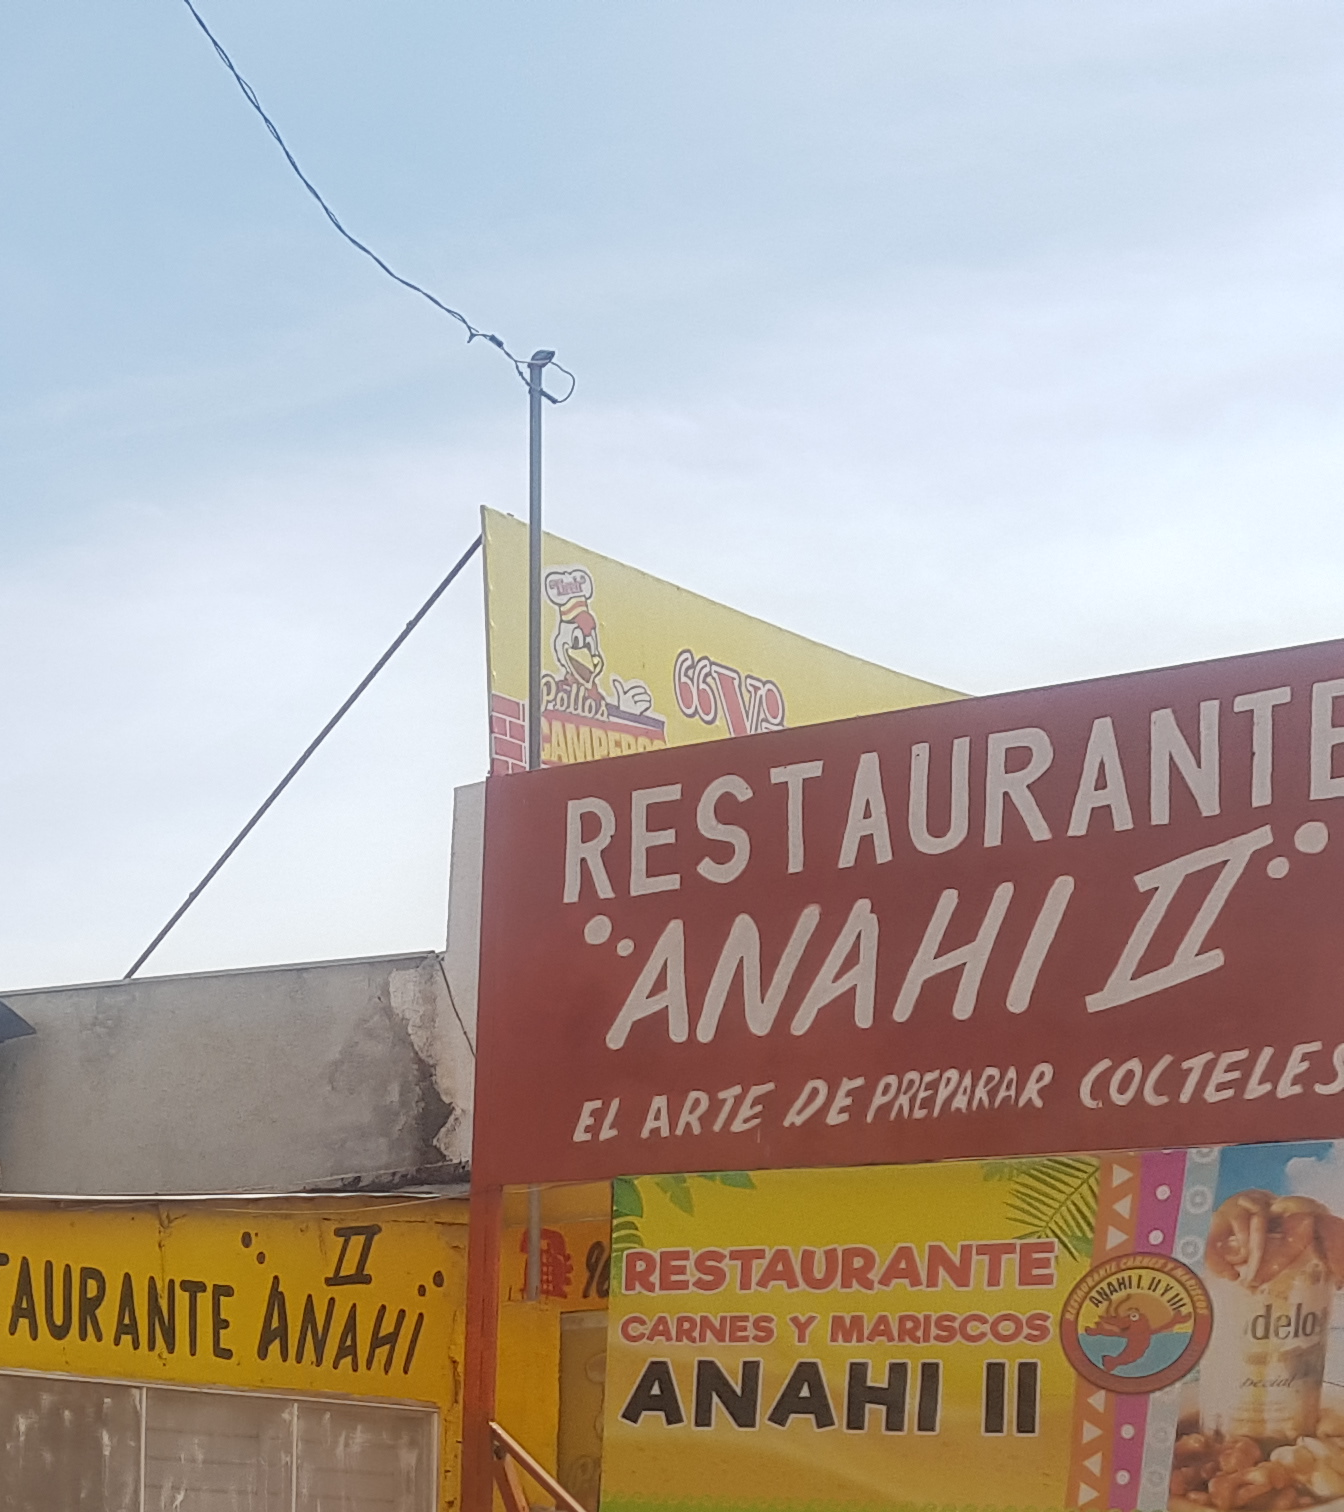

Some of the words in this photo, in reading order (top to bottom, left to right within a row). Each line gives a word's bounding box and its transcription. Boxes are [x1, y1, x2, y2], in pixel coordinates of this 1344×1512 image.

[541, 674, 609, 722] Pollos
[541, 716, 667, 764] CAMPER
[563, 678, 1344, 904] RESTAURANTE
[606, 875, 1075, 1050] ANAHI
[1085, 823, 1274, 1014] II
[572, 1098, 619, 1143] EL
[640, 1081, 775, 1141] ARTE
[782, 1075, 866, 1129] DE
[865, 1061, 1054, 1125] PREPARAR
[1079, 1040, 1344, 1109] COCTELES
[324, 1223, 382, 1288] II
[623, 1239, 1058, 1294] RESTAURANTE
[1089, 1274, 1133, 1309] ANAHI
[1147, 1276, 1162, 1293] II
[1160, 1283, 1174, 1297] Y
[1167, 1292, 1187, 1311] III
[1244, 1303, 1316, 1341] delo
[257, 1274, 426, 1376] ANAHI
[619, 1313, 776, 1344] CARNES
[788, 1313, 819, 1344] Y
[829, 1312, 1053, 1345] MARISCOS
[619, 1358, 943, 1434] ANAHI
[982, 1360, 1040, 1435] II
